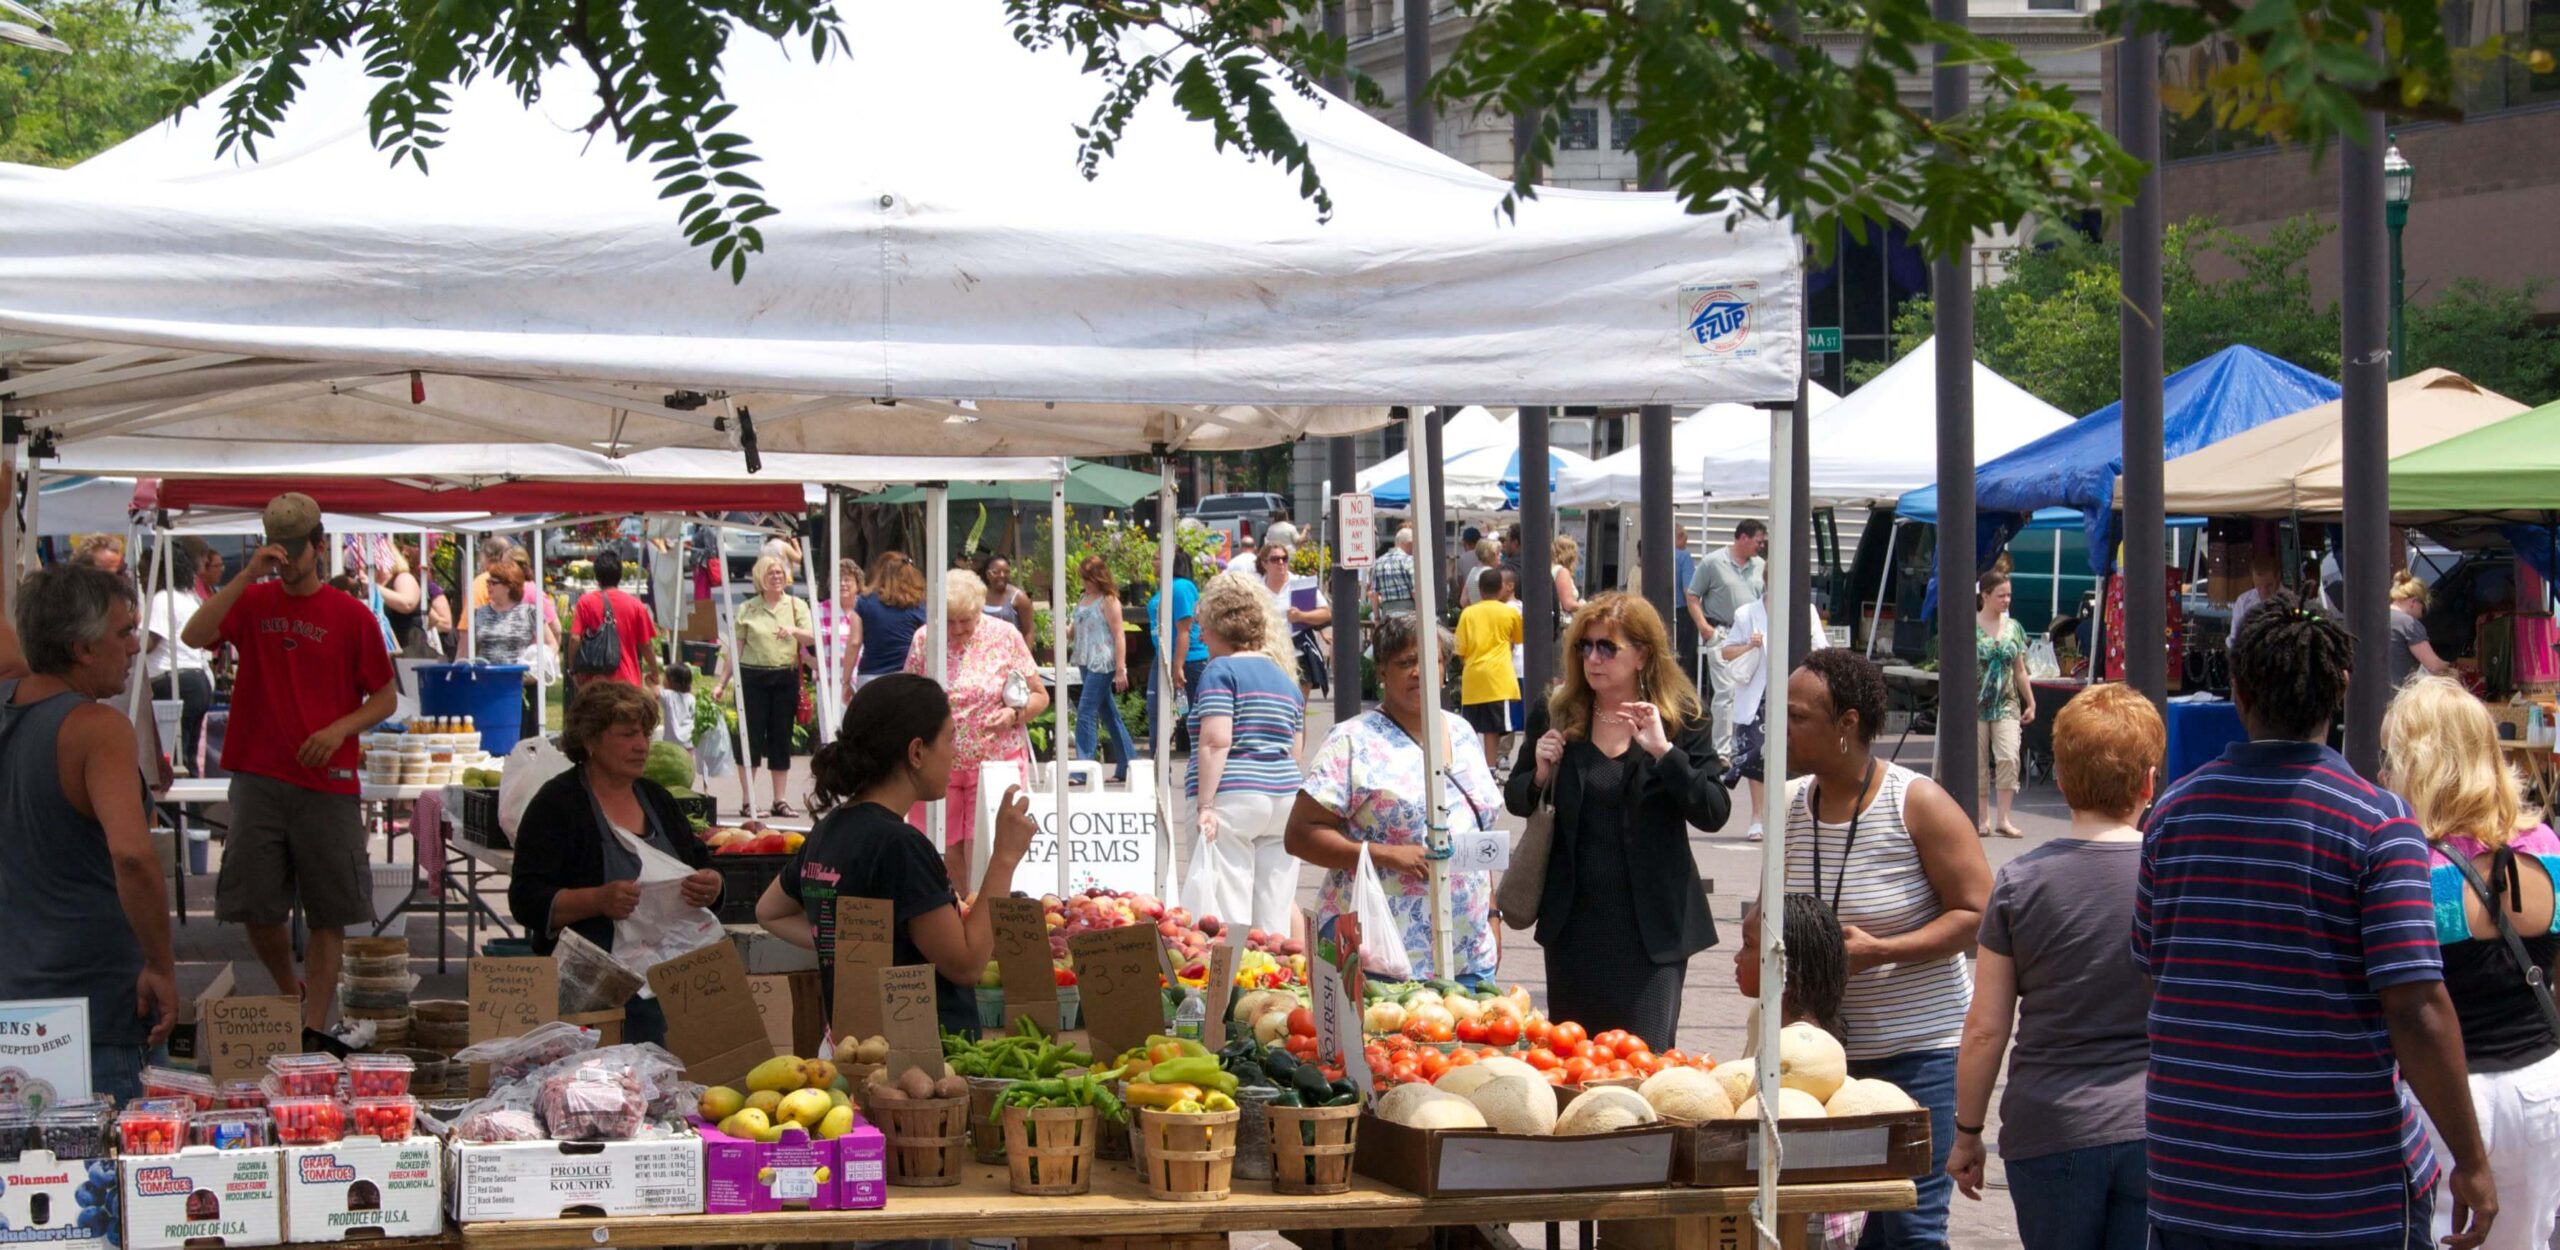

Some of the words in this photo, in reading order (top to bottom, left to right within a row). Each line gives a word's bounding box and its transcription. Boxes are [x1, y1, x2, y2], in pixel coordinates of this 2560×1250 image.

[1826, 337, 1837, 347] ST
[1350, 501, 1362, 514] NO
[1345, 518, 1369, 527] PARKING
[1351, 531, 1363, 539] ANY
[1351, 543, 1364, 552] TIME
[292, 620, 327, 643] SOX
[1025, 840, 1139, 863] FARMS
[214, 1000, 269, 1020] Grape
[1324, 975, 1334, 1036] FRESH
[214, 1021, 293, 1035] Tomatoes
[41, 1034, 72, 1053] HERE!
[400, 1151, 423, 1160] GROWN
[424, 1151, 429, 1159] &
[237, 1162, 260, 1171] GROWN
[261, 1161, 267, 1170] &
[303, 1157, 334, 1168] GRAPE
[396, 1161, 420, 1170] PACKED
[139, 1169, 171, 1182] GRAPE
[233, 1172, 258, 1181] PACKED
[303, 1168, 353, 1181] TOMATOES
[551, 1165, 611, 1176] PRODUCE
[8, 1172, 69, 1186] Diamond
[139, 1181, 191, 1194] TOMATOES
[388, 1181, 422, 1190] WOOLWICH
[225, 1192, 260, 1201] WOOLWICH
[478, 1196, 491, 1204] Black
[328, 1212, 368, 1226] PRODUCE
[371, 1212, 383, 1224] OF
[385, 1210, 410, 1223] U.S.A.
[165, 1223, 205, 1238] PRODUCE
[208, 1223, 220, 1235] OF
[223, 1221, 248, 1235] U.S.A.
